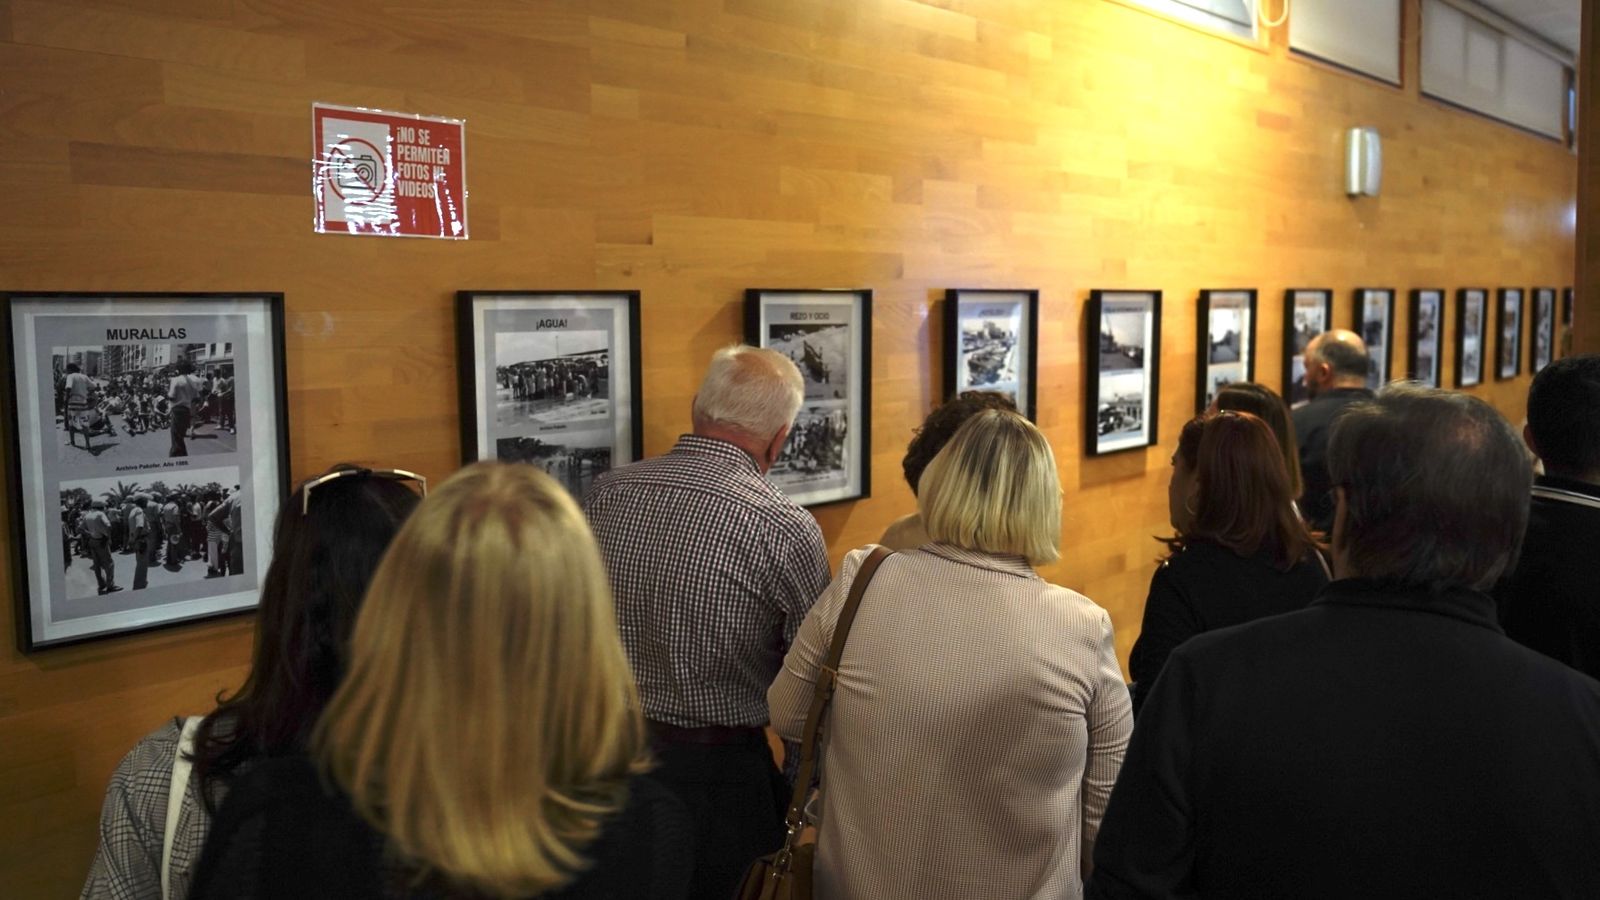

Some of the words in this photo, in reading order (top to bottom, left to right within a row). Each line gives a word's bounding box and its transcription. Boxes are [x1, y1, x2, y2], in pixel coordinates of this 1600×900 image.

[418, 128, 431, 145] SE
[397, 144, 450, 165] PERMITEN
[397, 162, 430, 181] FOTOS
[789, 312, 808, 320] REZO
[536, 318, 568, 331] ¡AGUA!
[106, 327, 187, 341] MURALLAS
